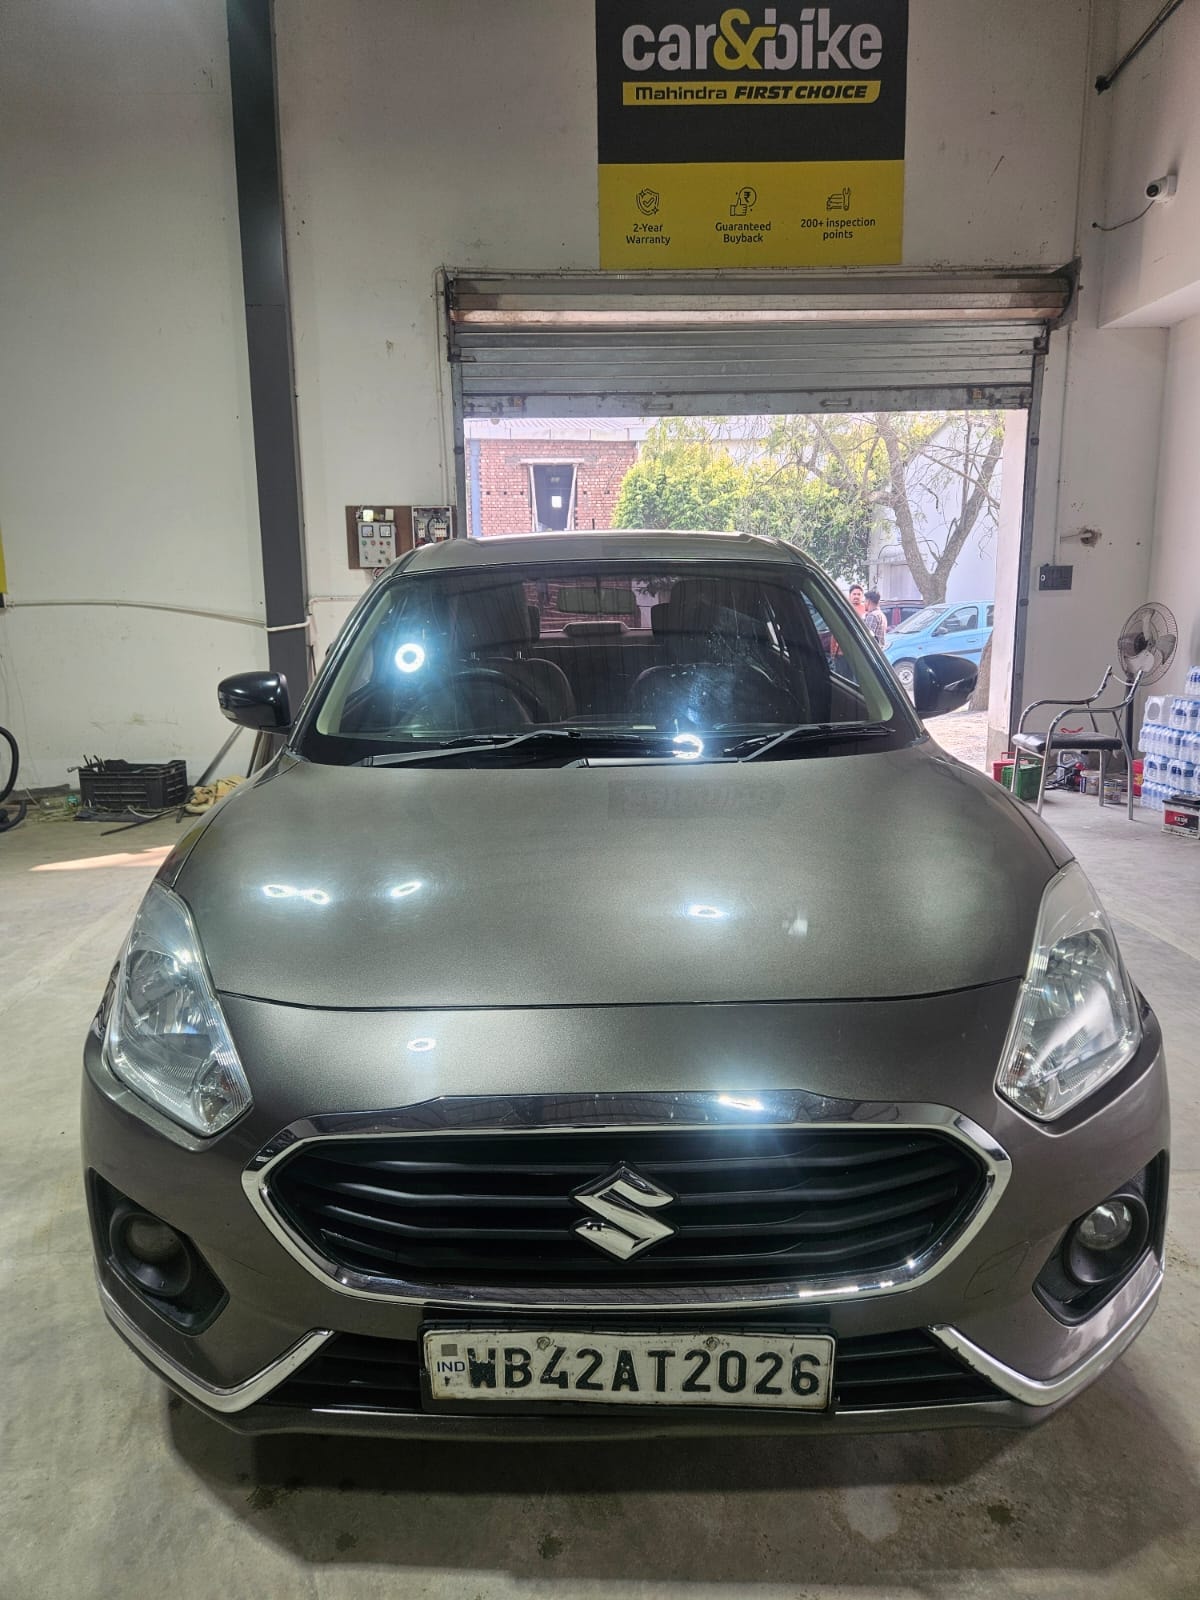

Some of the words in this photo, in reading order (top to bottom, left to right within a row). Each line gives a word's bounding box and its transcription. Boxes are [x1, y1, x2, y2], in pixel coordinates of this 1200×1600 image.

[622, 8, 882, 71] car&bike
[635, 86, 727, 100] Mahindra
[734, 86, 792, 99] FIRST
[795, 85, 867, 99] CHOICE
[632, 223, 663, 234] 2-Year
[715, 222, 771, 233] Guaranteed
[800, 218, 824, 229] 200+
[826, 217, 876, 229] inspection
[723, 233, 763, 244] Buyback
[822, 229, 853, 240] points
[625, 235, 671, 246] Warranty
[437, 1361, 466, 1373] IND
[467, 1346, 820, 1396] WB42AT2026
